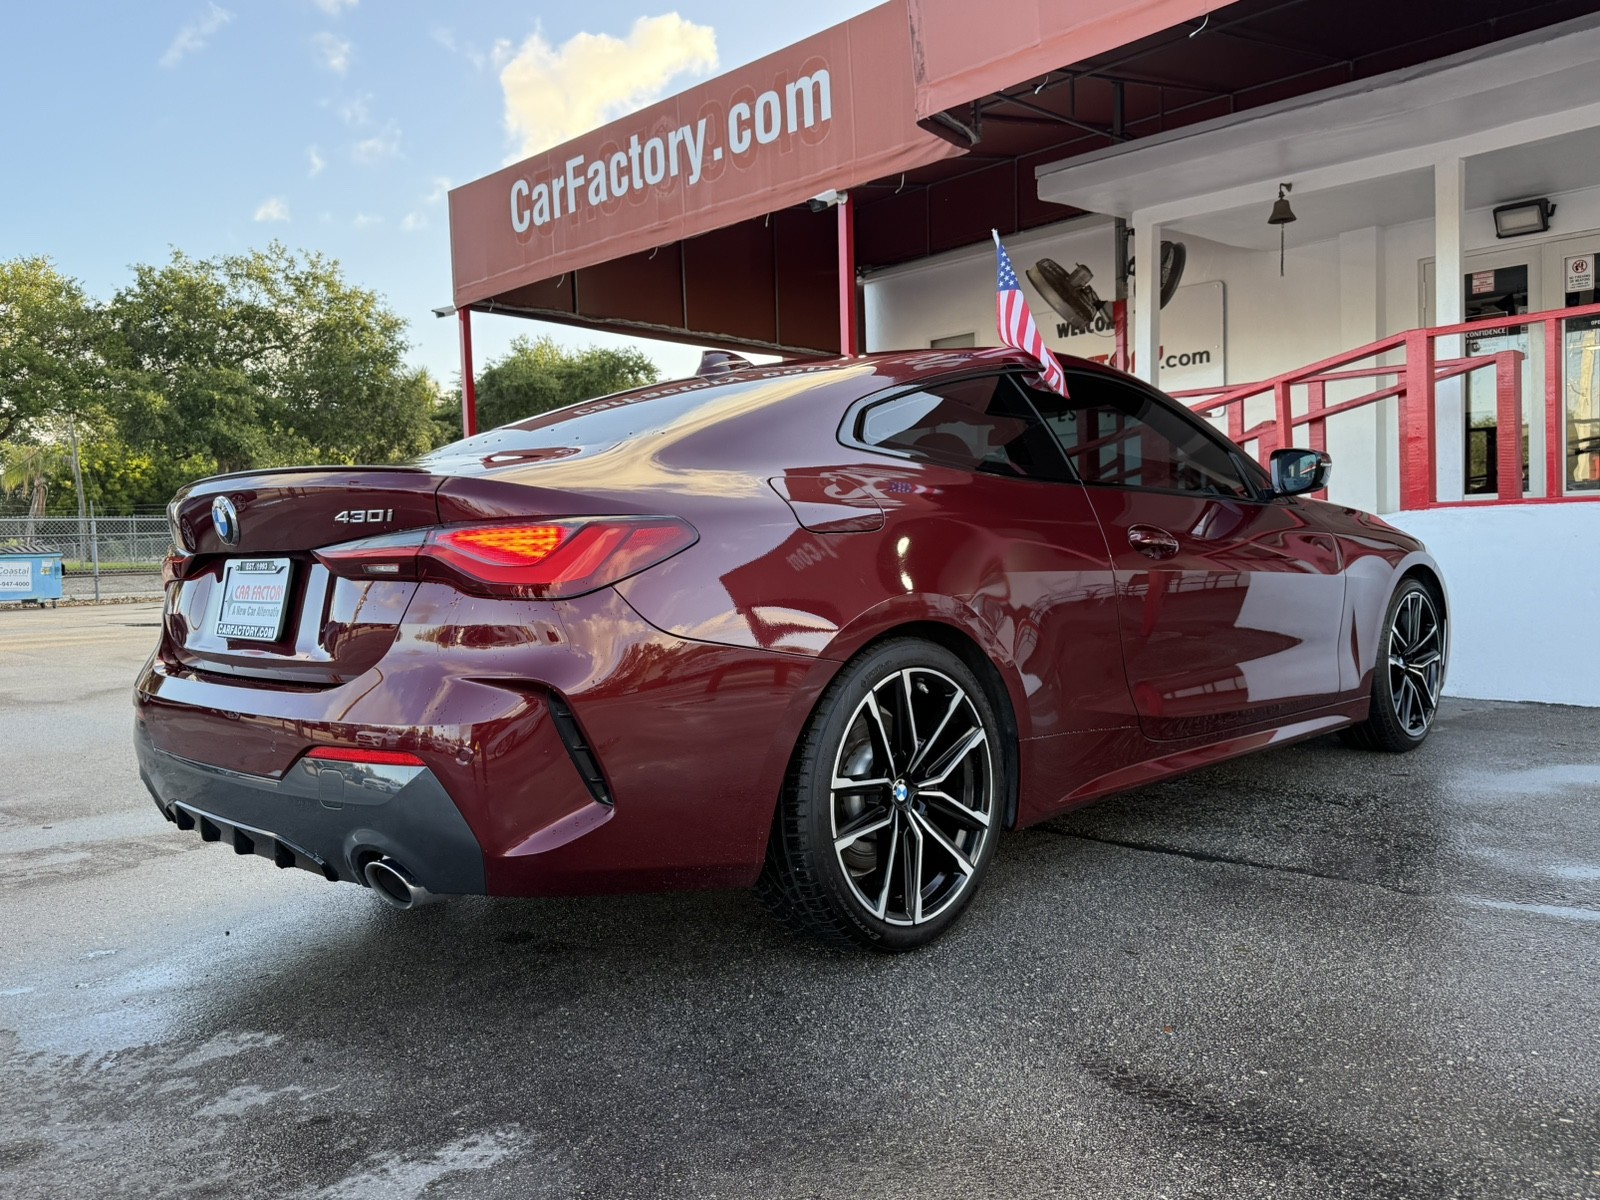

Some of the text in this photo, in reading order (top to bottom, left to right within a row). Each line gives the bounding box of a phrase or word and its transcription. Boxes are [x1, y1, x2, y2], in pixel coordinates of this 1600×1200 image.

[1465, 327, 1506, 338] CONFIDENCE
[334, 508, 393, 523] 430i
[235, 585, 250, 600] CAR
[217, 623, 274, 638] CARFACTORY.COM
